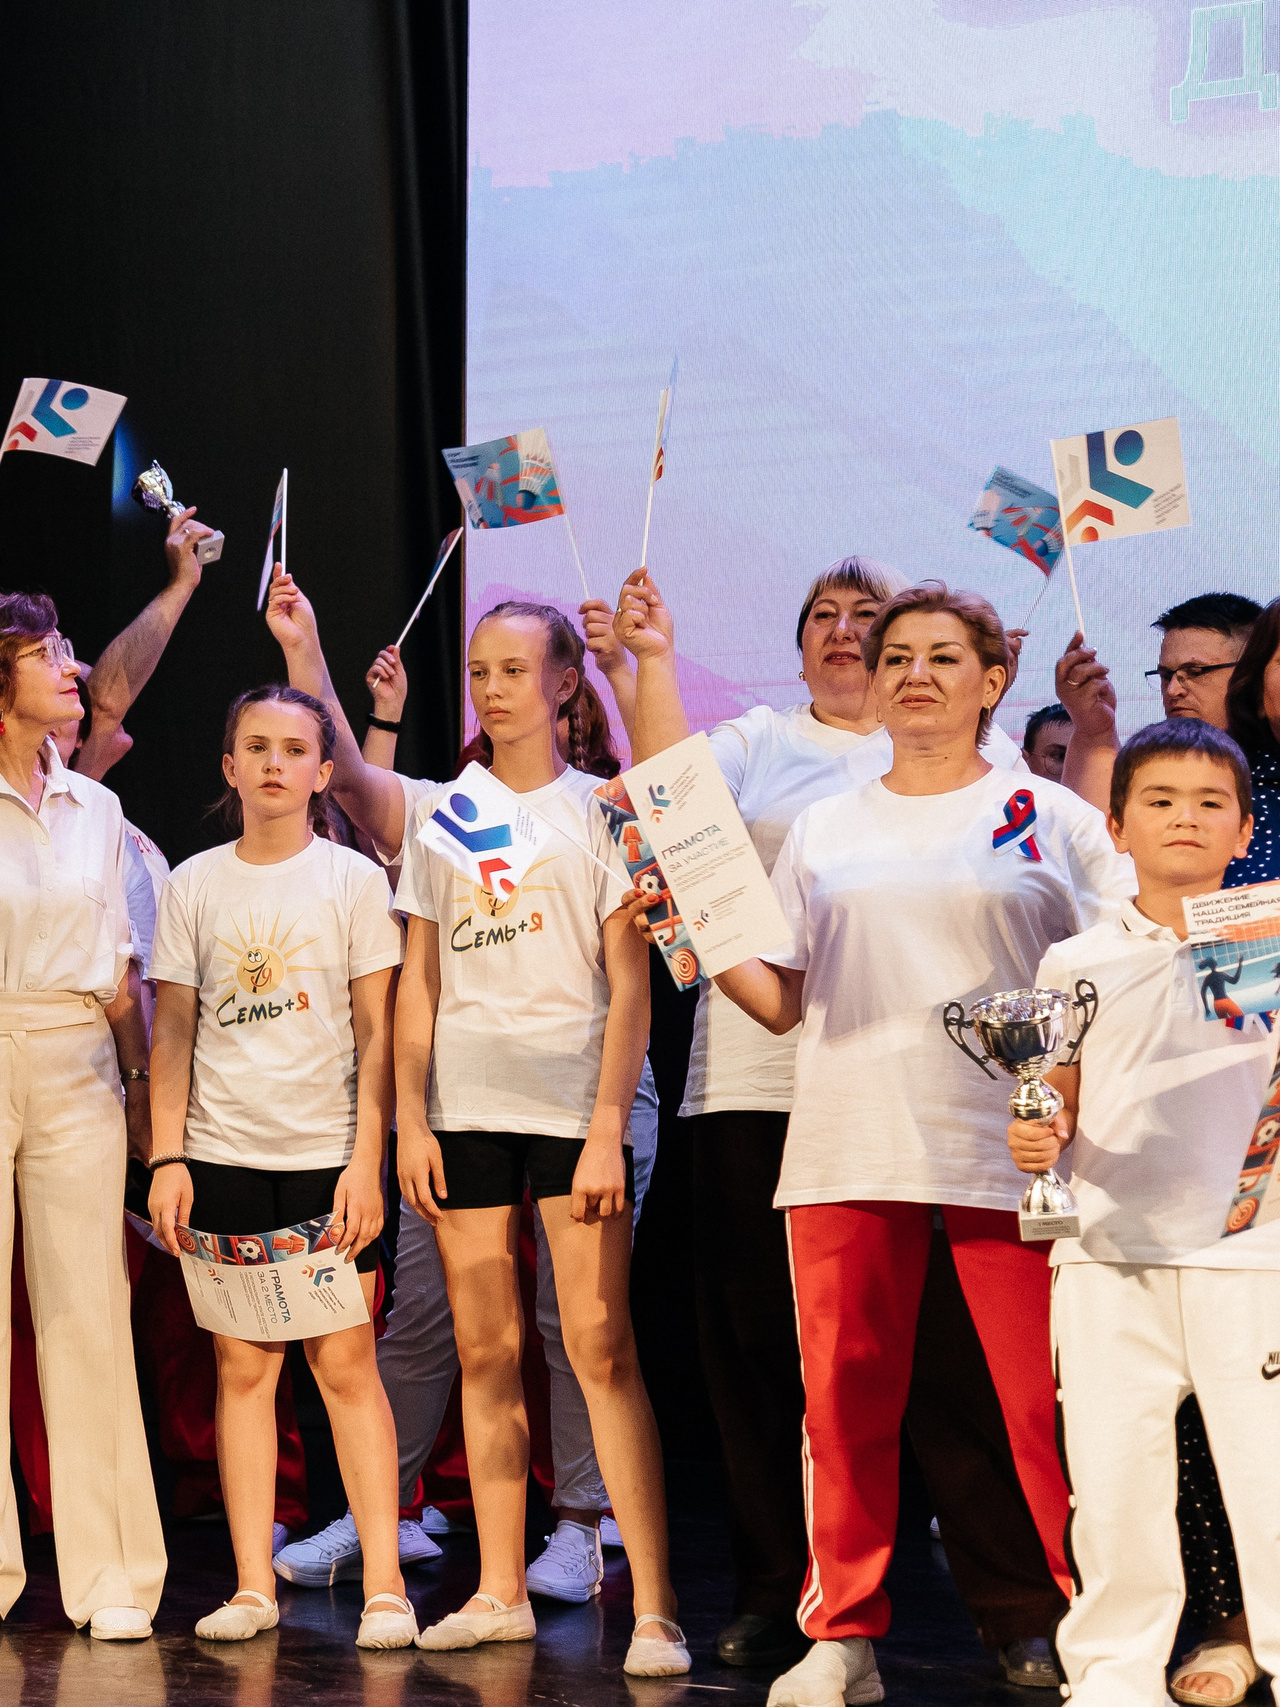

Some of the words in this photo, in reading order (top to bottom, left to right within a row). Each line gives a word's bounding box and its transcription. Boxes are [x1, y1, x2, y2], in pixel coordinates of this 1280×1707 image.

[661, 824, 722, 860] ГРАМОТА
[1192, 894, 1250, 909] ДВИЖЕНИЕ
[1193, 907, 1225, 918] НАША
[1195, 912, 1251, 926] ТРАДИЦИЯ
[257, 1271, 266, 1284] ЗА
[264, 1294, 278, 1324] МЕСТО
[269, 1269, 291, 1323] ГРАМОТА
